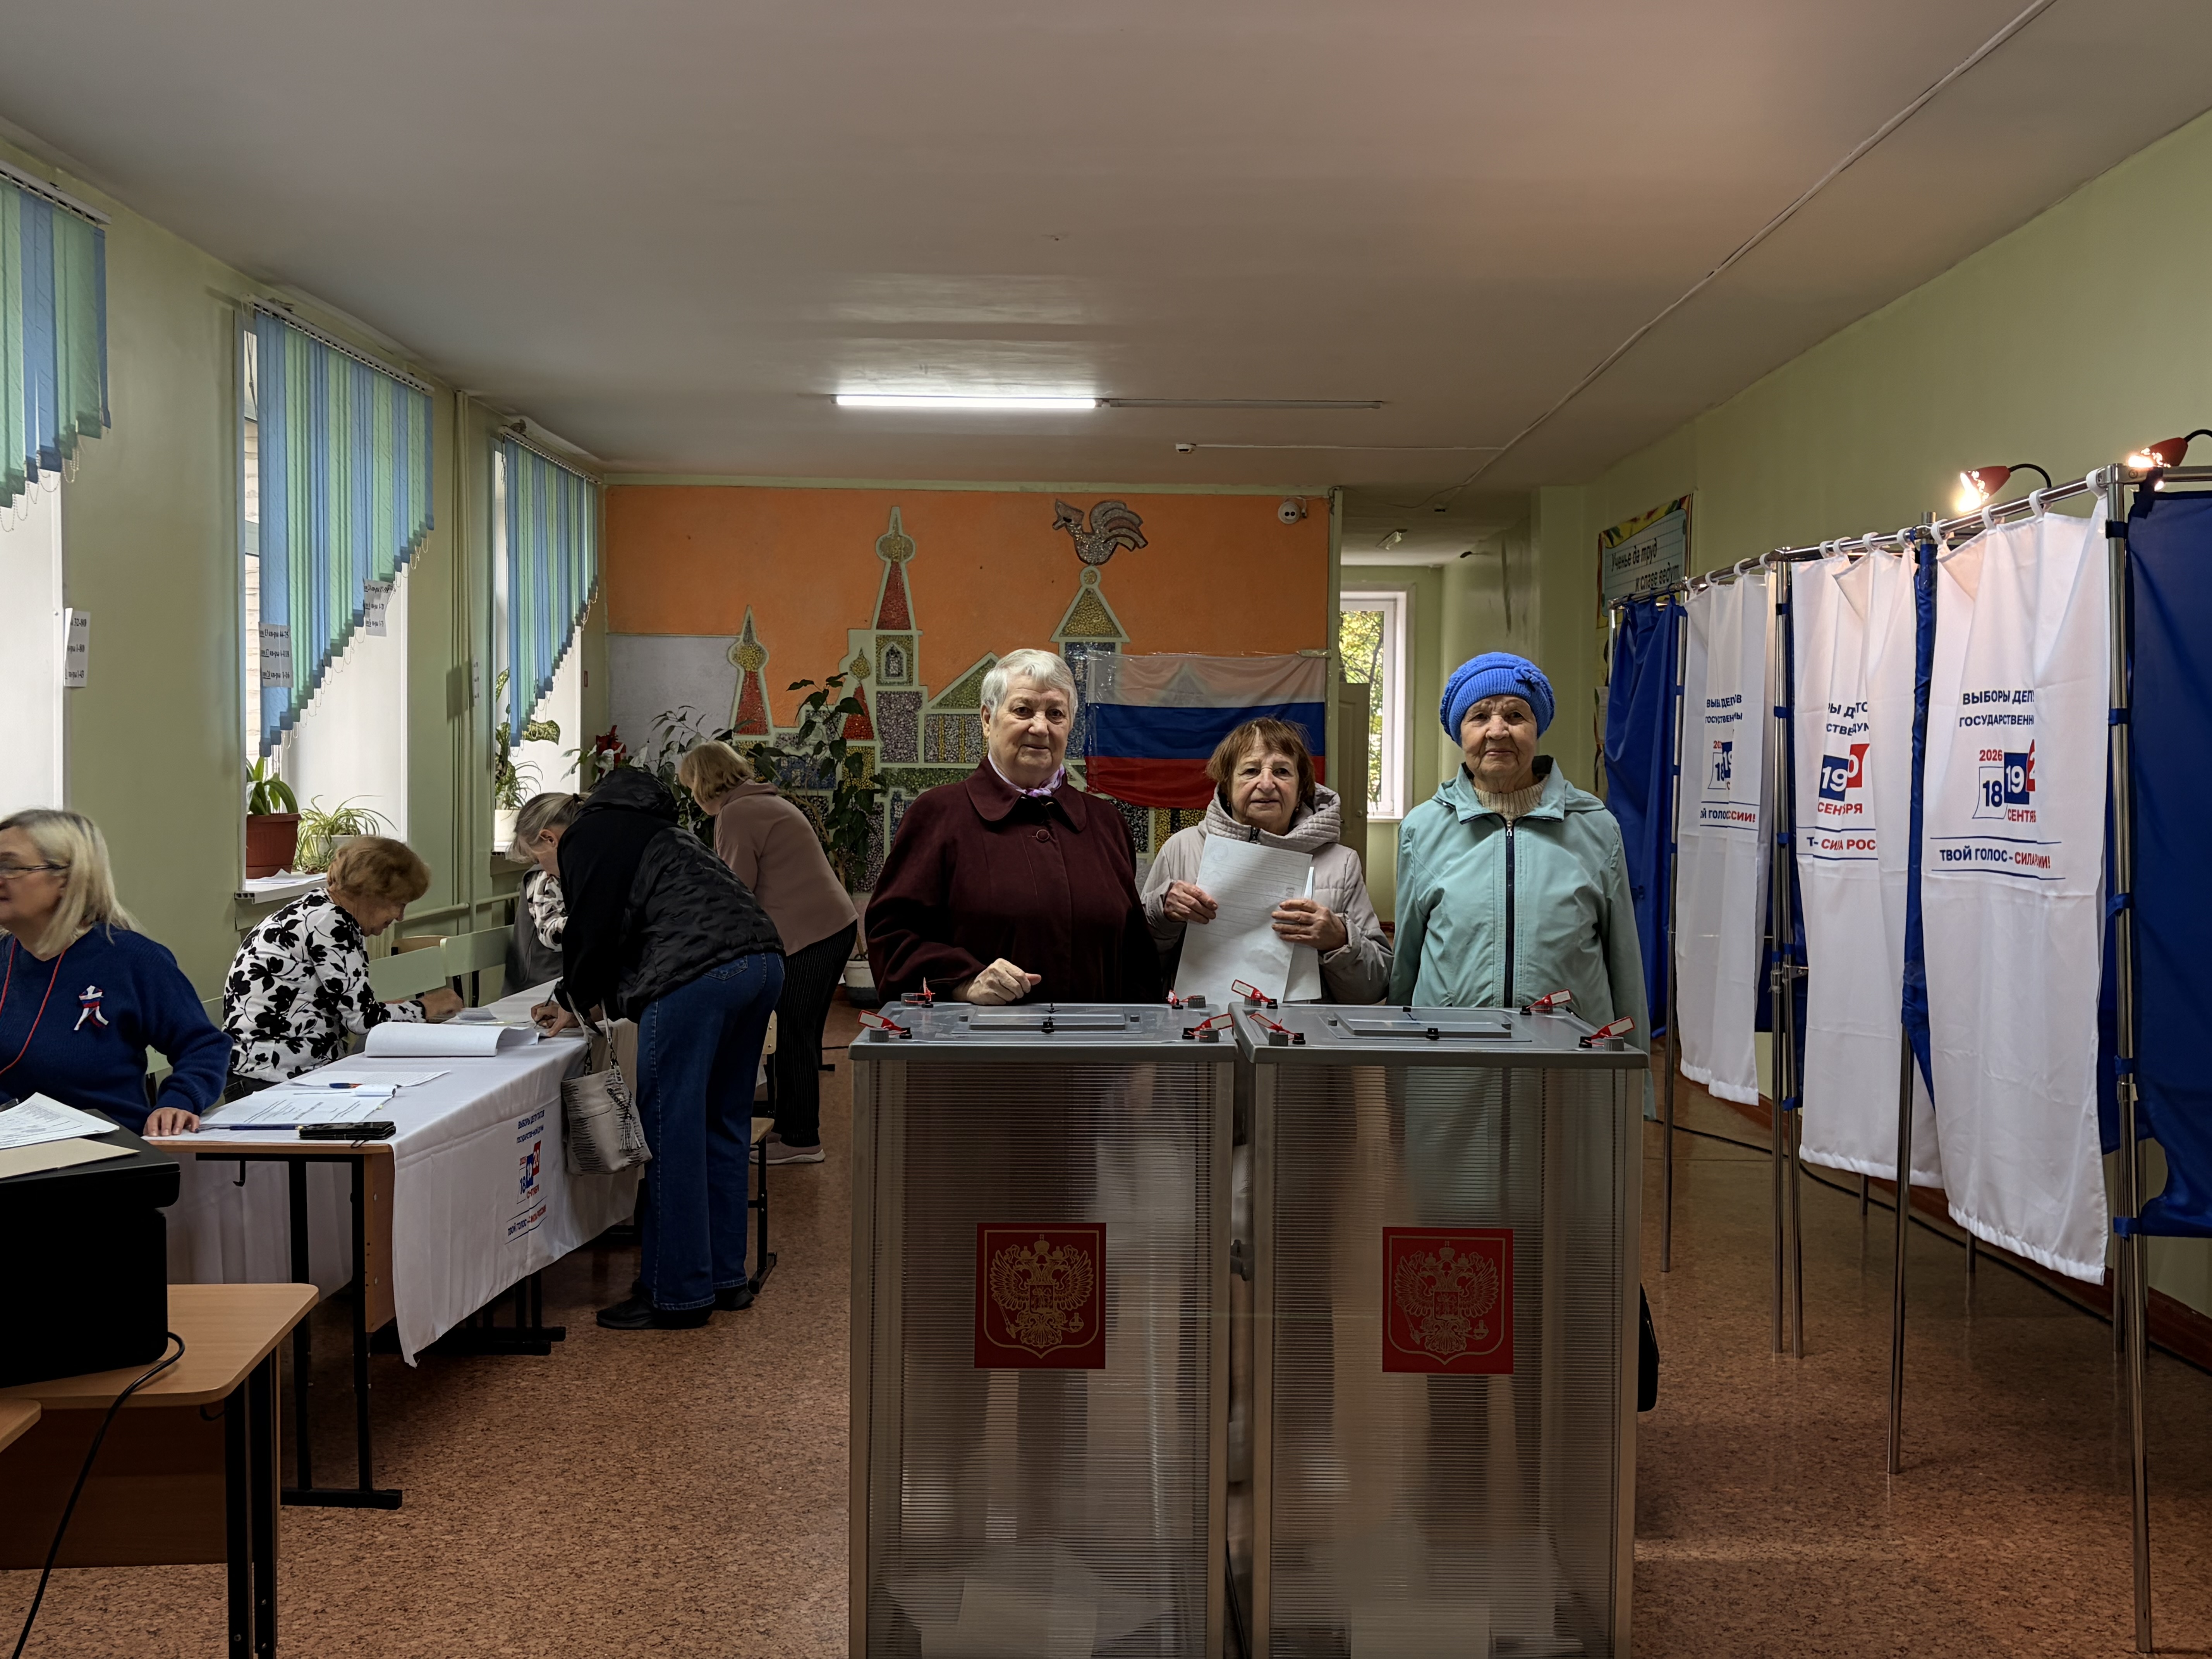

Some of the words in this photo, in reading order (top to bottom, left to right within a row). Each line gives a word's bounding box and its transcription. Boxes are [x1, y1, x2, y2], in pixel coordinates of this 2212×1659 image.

[1963, 690, 2010, 705] ВЫБОРЫ
[1979, 749, 2002, 762] 2026
[1821, 766, 1849, 792] 19
[2006, 765, 2025, 793] 19
[1982, 780, 2002, 807] 18
[1939, 845, 1972, 861] ТВОЙ
[1975, 848, 2008, 862] ГОЛОС
[520, 1176, 526, 1195] 18
